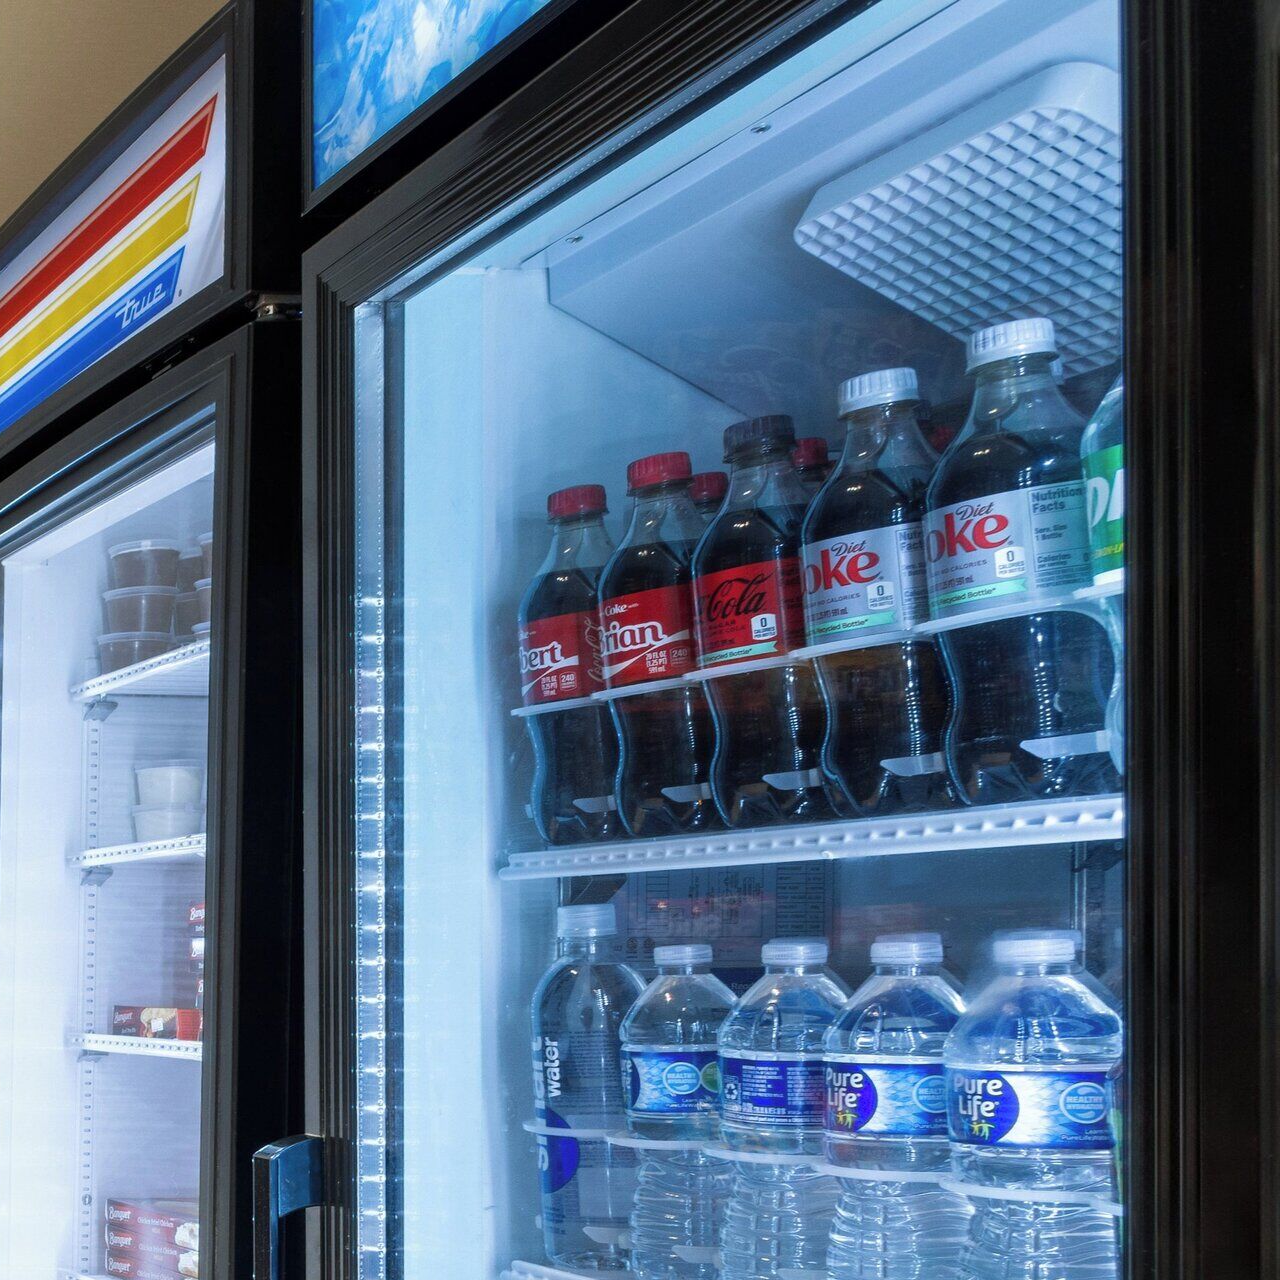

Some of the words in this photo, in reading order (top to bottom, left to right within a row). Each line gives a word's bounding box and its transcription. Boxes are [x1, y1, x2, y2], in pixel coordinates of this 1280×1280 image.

[116, 282, 168, 329] true
[1031, 487, 1084, 502] Nutrition
[956, 502, 995, 520] Diet
[1032, 500, 1066, 511] Facts
[831, 540, 867, 557] Diet
[1006, 549, 1015, 562] 0
[876, 585, 885, 597] 0
[605, 603, 628, 616] Coke
[760, 617, 767, 628] 0
[544, 1036, 562, 1099] water
[826, 1068, 864, 1089] Pure
[954, 1074, 1003, 1096] Pure
[828, 1087, 858, 1112] Life
[958, 1096, 995, 1121] Life
